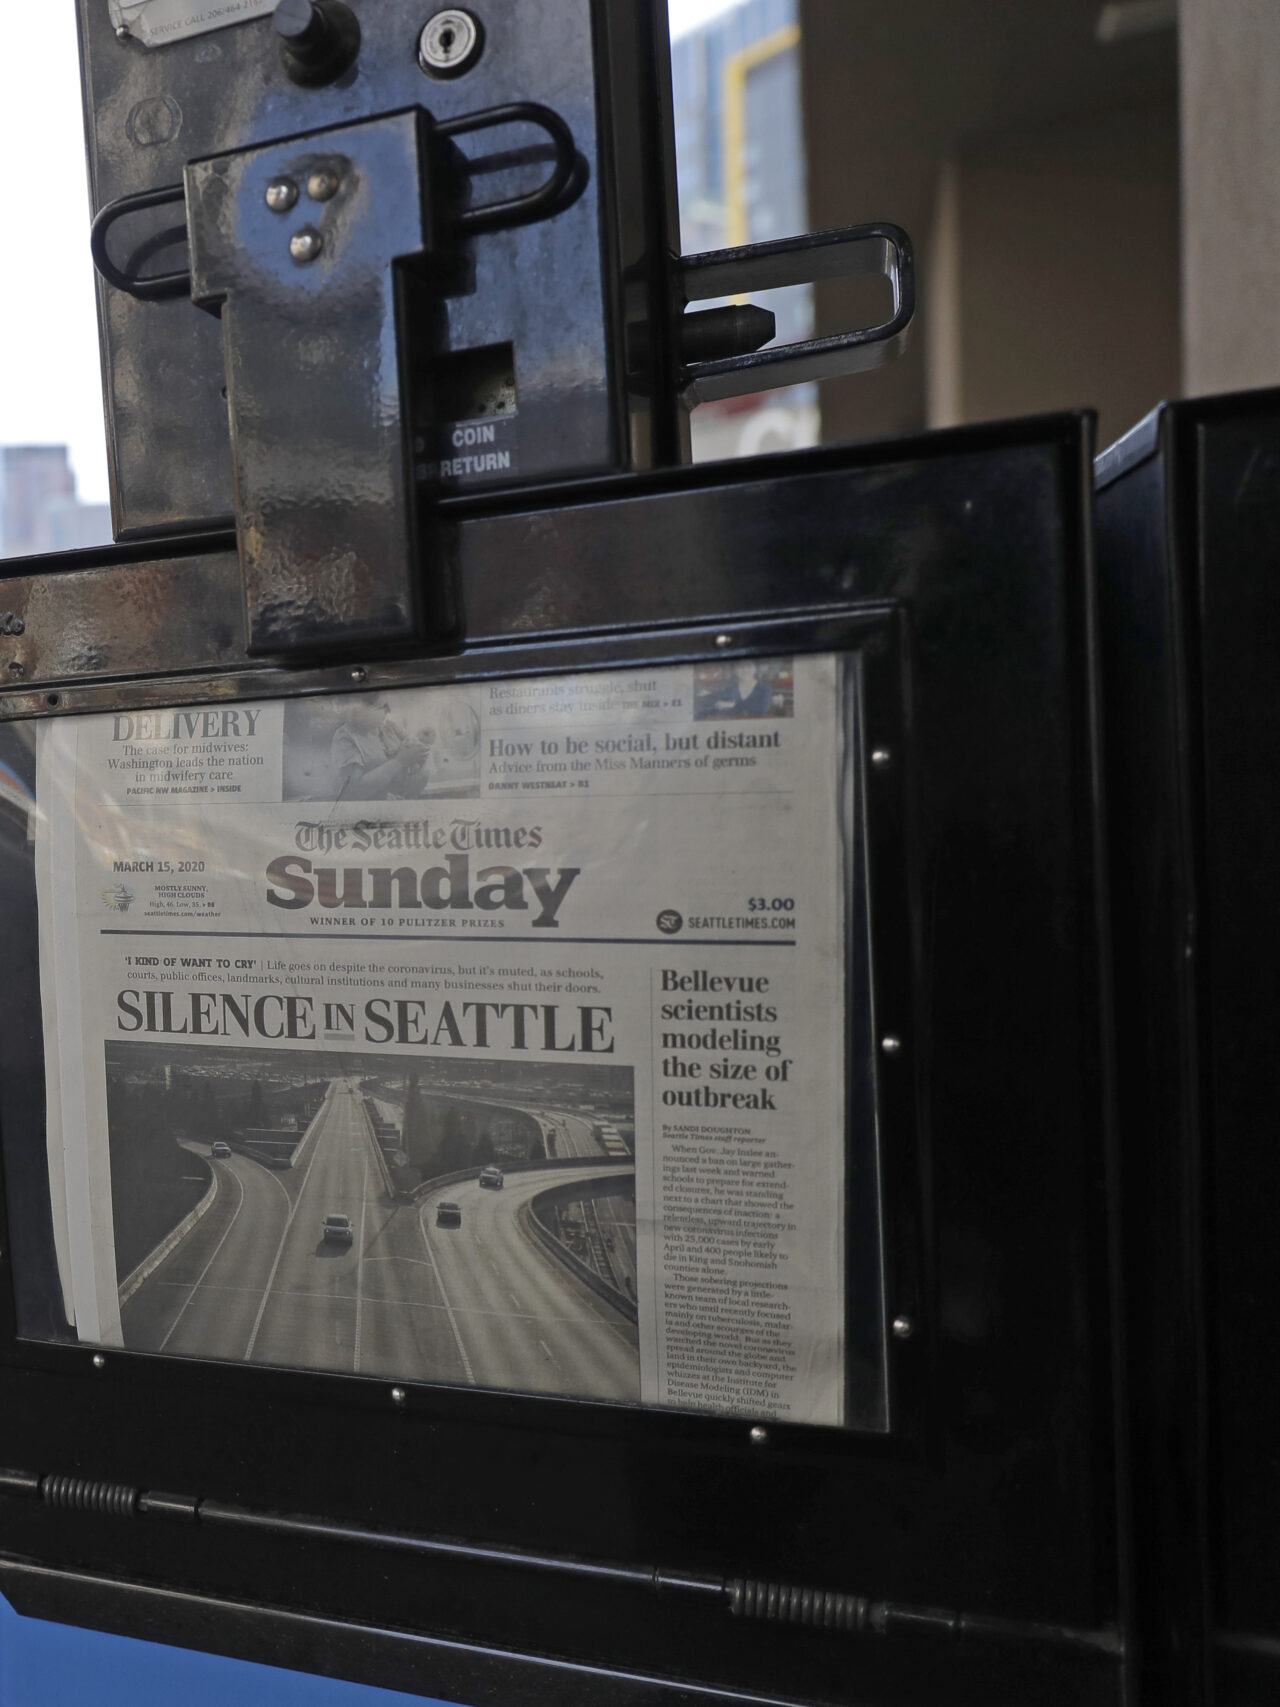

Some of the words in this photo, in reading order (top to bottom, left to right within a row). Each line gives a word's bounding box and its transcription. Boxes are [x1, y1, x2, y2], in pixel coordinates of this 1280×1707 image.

[150, 20, 182, 35] SERVICE
[185, 15, 205, 26] CALL
[452, 425, 495, 447] COIN
[440, 451, 510, 477] RETURN
[627, 680, 657, 692] shut
[489, 705, 503, 716] as
[505, 702, 546, 715] diners
[112, 710, 262, 741] DELIVERY
[122, 745, 143, 756] The
[146, 746, 170, 755] case
[173, 744, 189, 754] for
[192, 742, 248, 753] midwives:
[489, 739, 533, 757] How
[540, 740, 558, 755] to
[566, 736, 588, 754] be
[594, 734, 657, 755] social,
[664, 732, 699, 751] but
[706, 730, 781, 750] distant
[108, 758, 172, 770] Washington
[176, 758, 203, 768] leads
[207, 756, 225, 766] the
[228, 755, 263, 766] nation
[489, 761, 532, 774] Advice
[536, 761, 567, 772] from
[570, 759, 592, 772] the
[594, 758, 626, 771] Miss
[630, 756, 691, 770] Manners
[694, 754, 710, 768] of
[712, 756, 756, 771] germs
[135, 772, 145, 782] in
[149, 771, 206, 783] midwifery
[209, 772, 233, 781] care
[127, 787, 154, 795] PACIFIC
[170, 786, 208, 794] MAGAZINE
[217, 785, 241, 793] INSIDE
[488, 782, 518, 790] DANNY
[294, 820, 348, 855] The
[351, 819, 447, 852] Seattle
[449, 817, 543, 851] Times
[113, 861, 153, 872] MARCH
[158, 861, 174, 874] 15,
[178, 861, 205, 872] 2020
[265, 854, 581, 928] Sunday
[748, 897, 795, 912] $3.00
[310, 917, 356, 926] WINNER
[361, 918, 376, 926] OF
[381, 918, 394, 926] 10
[399, 919, 456, 927] PULITZER
[462, 919, 505, 928] PRIZES
[688, 917, 795, 929] SEATTLETIMES.COM
[135, 957, 159, 966] KIND
[163, 958, 176, 966] OF
[181, 959, 212, 967] WANT
[216, 959, 230, 968] TO
[235, 960, 257, 969] CRY'
[267, 961, 286, 971] Life
[289, 963, 311, 973] goes
[329, 962, 366, 974] despite
[369, 963, 384, 973] the
[388, 965, 455, 977] coronavirus,
[458, 965, 476, 975] but
[479, 966, 495, 976] it's
[498, 967, 538, 978] muted,
[555, 968, 604, 980] schools,
[127, 971, 158, 980] courts,
[160, 972, 190, 982] public
[192, 972, 225, 983] offices,
[228, 973, 283, 985] landmarks,
[285, 975, 324, 985] cultural
[327, 976, 385, 987] institutions
[388, 978, 408, 988] and
[411, 980, 440, 991] many
[444, 979, 504, 991] businesses
[507, 981, 531, 992] shut
[535, 981, 562, 992] their
[565, 982, 601, 993] doors.
[660, 969, 770, 993] Bellevue
[660, 999, 778, 1023] scientists
[116, 989, 316, 1040] SILENCE
[323, 1002, 356, 1031] IN
[364, 998, 615, 1053] SEATTLE
[662, 1027, 782, 1057] modeling
[662, 1055, 702, 1079] the
[709, 1057, 757, 1081] size
[764, 1059, 793, 1082] of
[662, 1085, 777, 1110] outbreak
[701, 1126, 751, 1134] DOUGHTON
[714, 1134, 732, 1143] staff
[733, 1136, 766, 1144] reporter
[672, 1144, 697, 1153] When
[699, 1146, 719, 1154] Gov.
[721, 1147, 736, 1157] Jay
[738, 1148, 763, 1157] Inslee
[663, 1155, 700, 1164] nounced
[708, 1157, 724, 1165] ban
[739, 1158, 761, 1168] large
[763, 1160, 796, 1169] gather-
[663, 1164, 680, 1173] ings
[682, 1165, 696, 1173] last
[698, 1166, 720, 1175] week
[724, 1168, 740, 1176] and
[742, 1169, 775, 1178] warned
[663, 1174, 694, 1183] schools
[706, 1178, 740, 1186] prepare
[742, 1179, 753, 1187] for
[756, 1180, 789, 1189] extend-
[664, 1234, 683, 1242] with
[684, 1234, 715, 1244] 25,000
[716, 1238, 739, 1246] cases
[753, 1240, 775, 1250] early
[667, 1378, 699, 1389] Disease
[700, 1382, 740, 1394] Modeling
[742, 1387, 768, 1398] (IDM)
